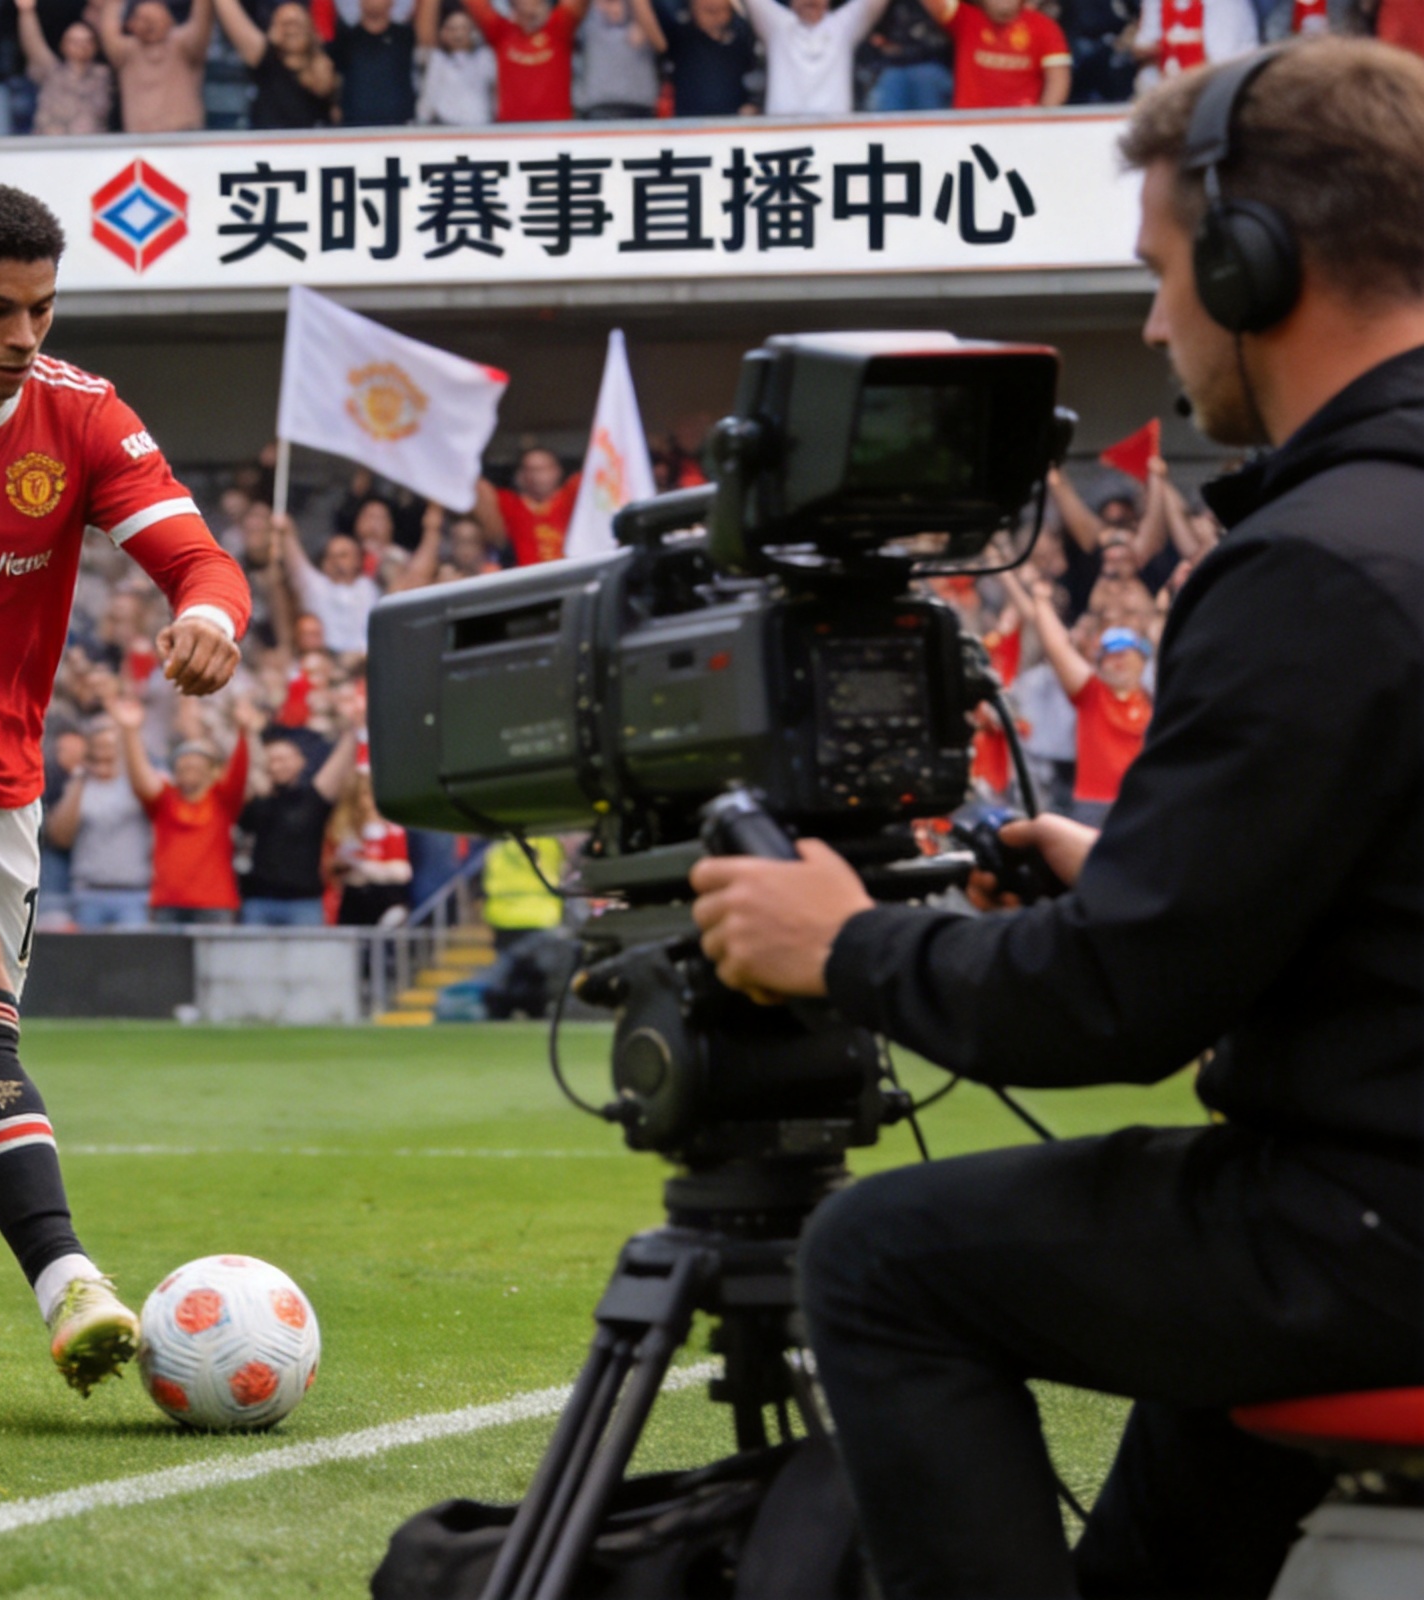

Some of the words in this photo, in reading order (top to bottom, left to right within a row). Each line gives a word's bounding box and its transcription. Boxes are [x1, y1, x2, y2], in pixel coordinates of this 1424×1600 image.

[217, 142, 1037, 264] 实时赛事直播中心
